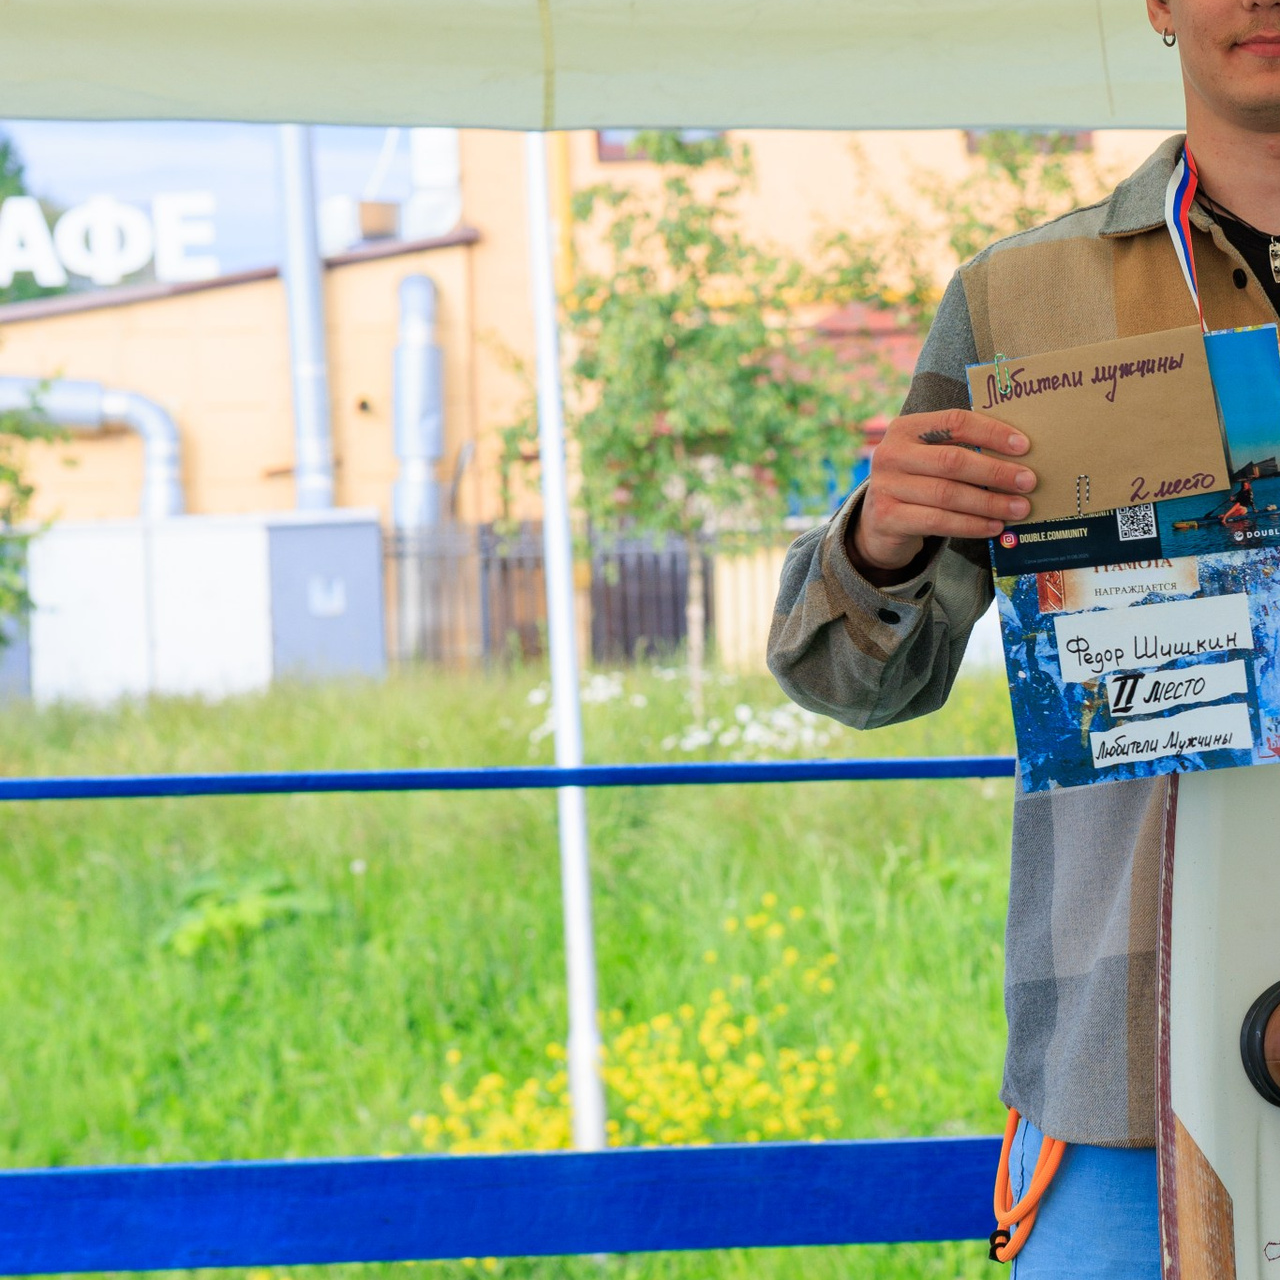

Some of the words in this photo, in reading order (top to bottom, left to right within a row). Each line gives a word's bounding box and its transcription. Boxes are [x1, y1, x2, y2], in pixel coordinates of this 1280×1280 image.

[982, 367, 1083, 409] Любители
[1091, 353, 1184, 403] мужчины
[1130, 476, 1150, 502] 2
[1153, 472, 1216, 498] место
[1019, 527, 1088, 544] DOUBLE.COMMUNITY
[1094, 582, 1178, 597] НАГРАЖДАЕТСЯ
[1066, 635, 1125, 673] Федор
[1134, 632, 1238, 660] Шишкин
[1111, 673, 1146, 714] II
[1095, 734, 1159, 760] Любители
[1162, 730, 1234, 757] Мужчины
